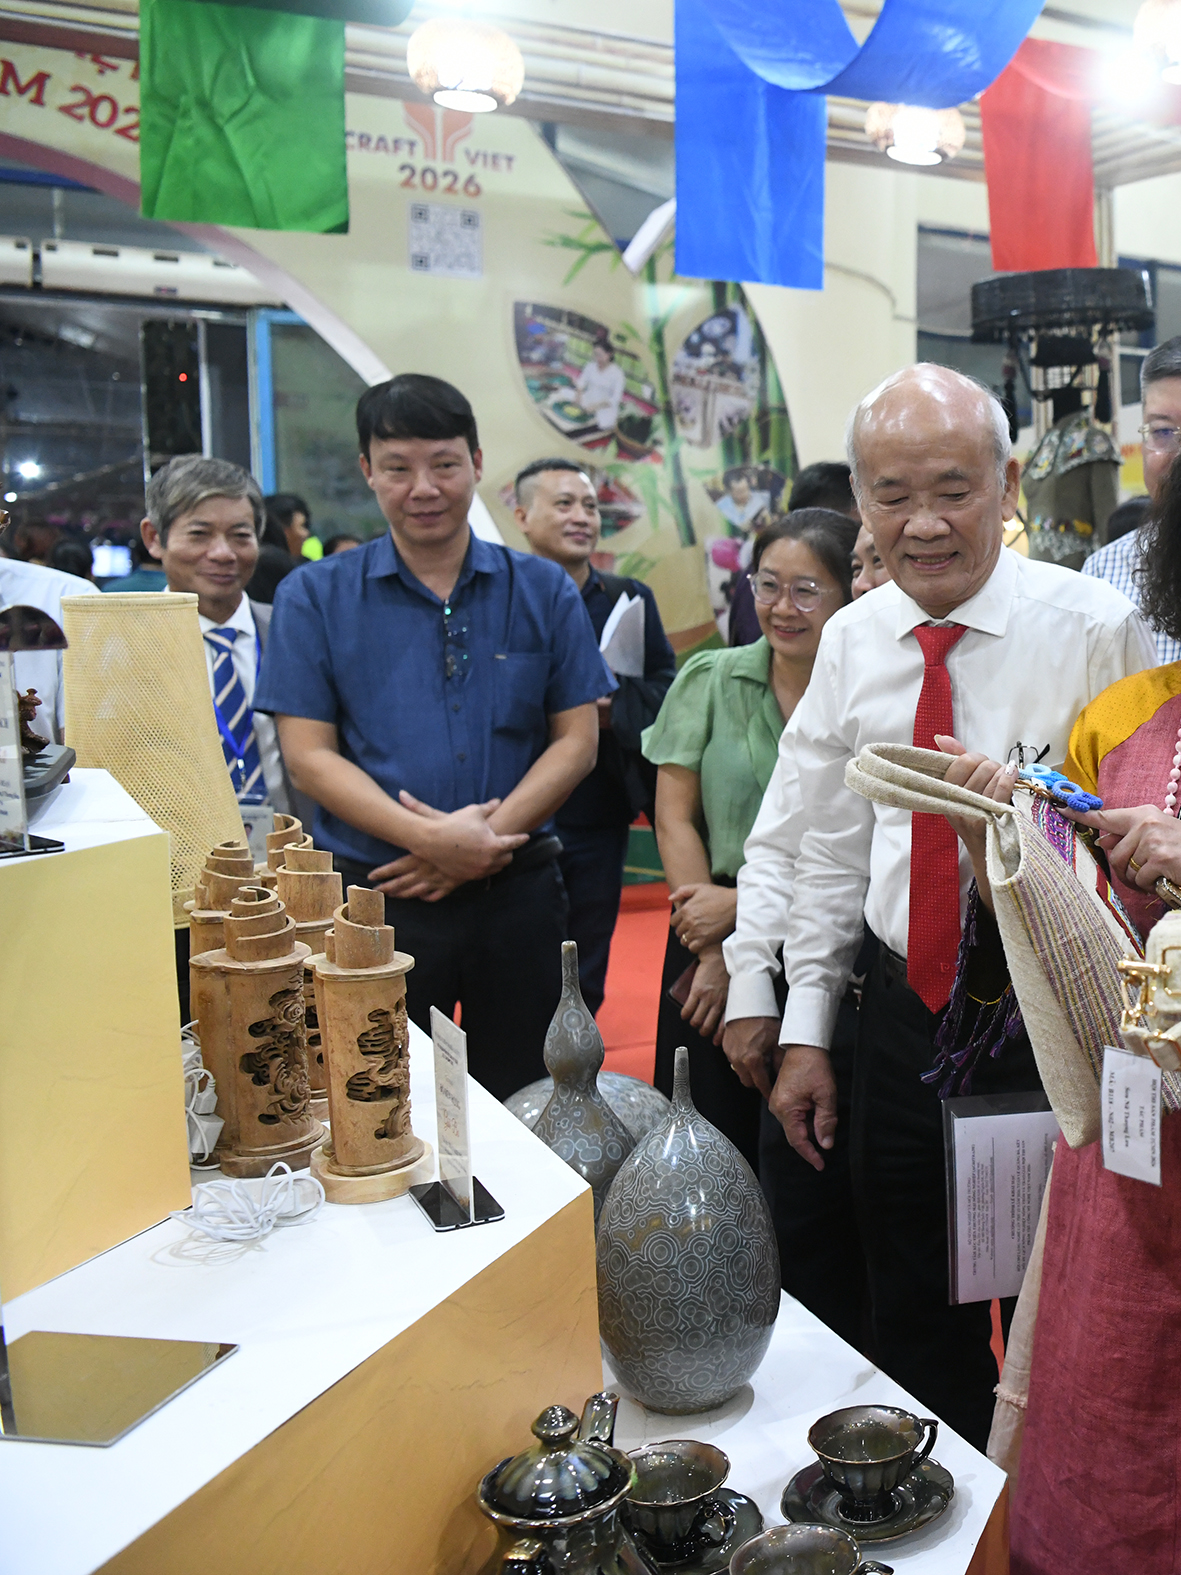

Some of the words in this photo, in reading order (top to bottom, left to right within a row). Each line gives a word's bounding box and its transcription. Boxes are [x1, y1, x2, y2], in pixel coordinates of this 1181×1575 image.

[346, 130, 417, 159] CRAFT
[464, 146, 515, 173] VIET
[398, 162, 482, 198] 2026
